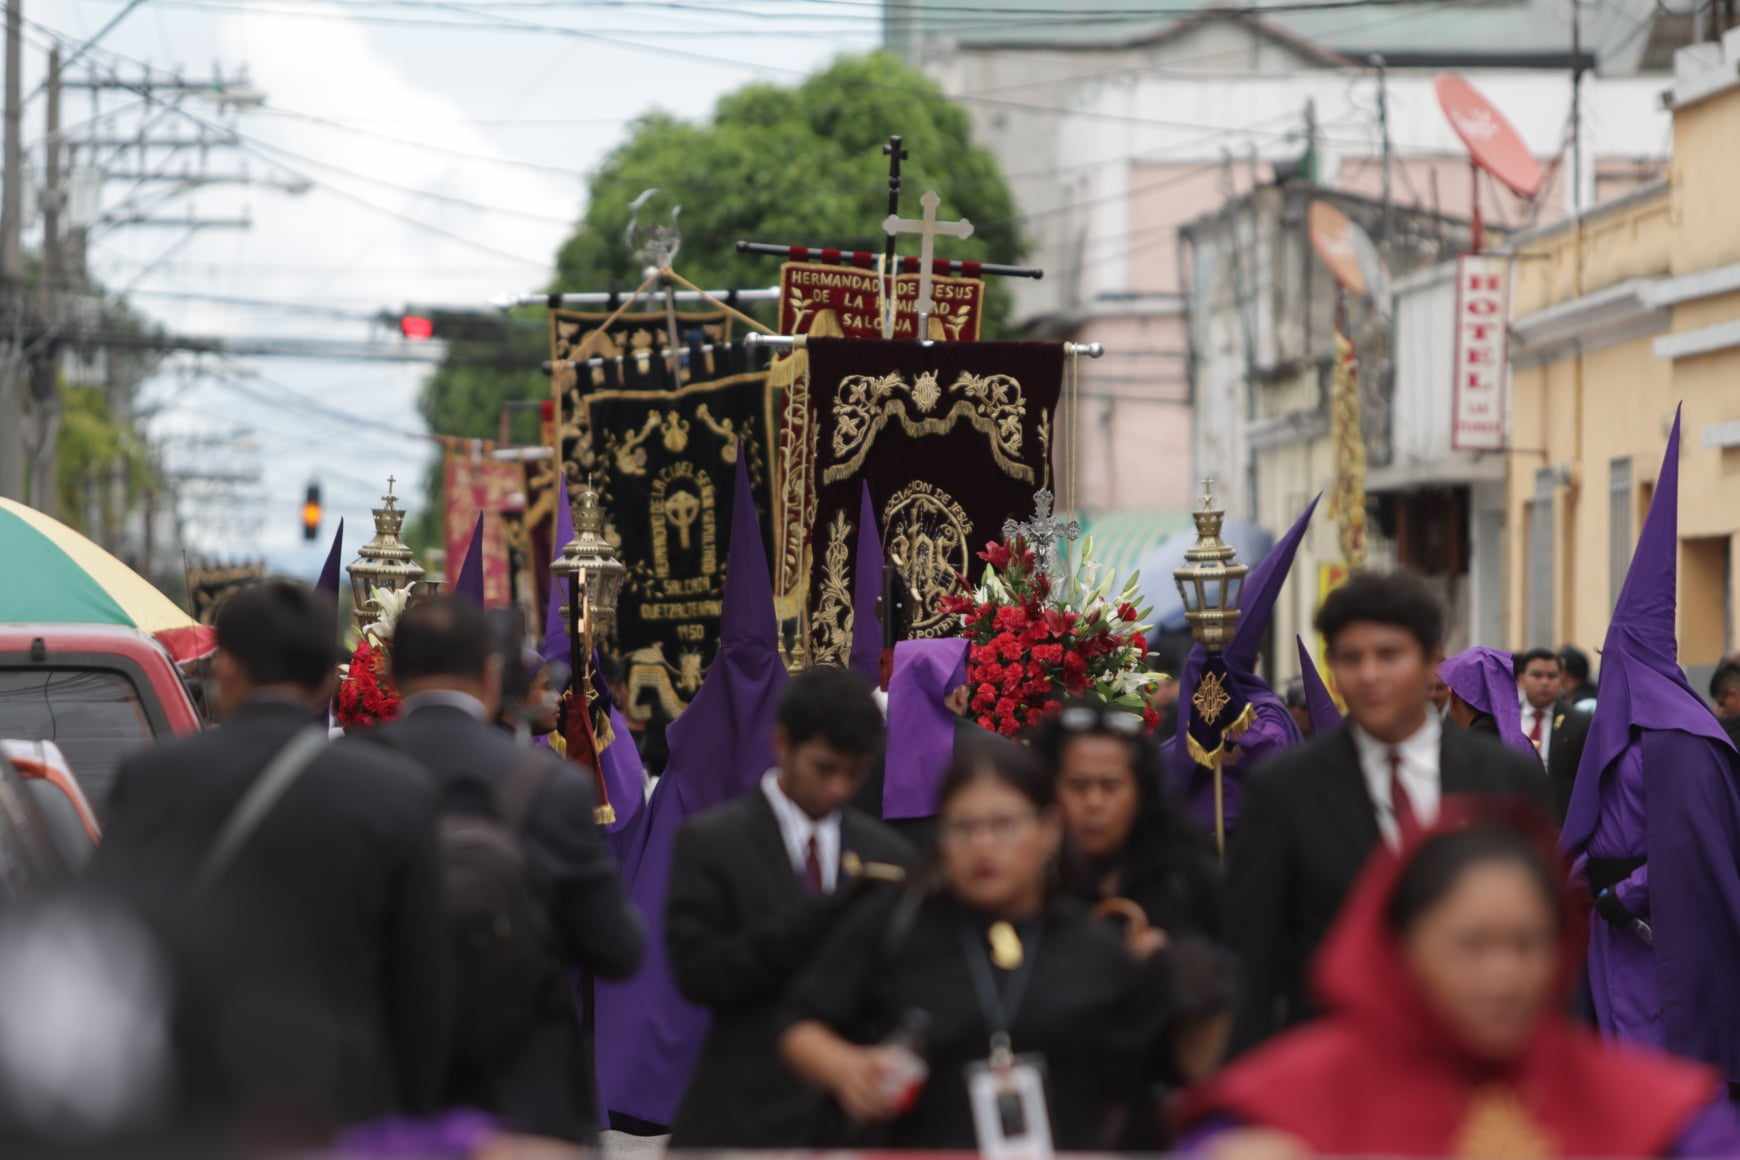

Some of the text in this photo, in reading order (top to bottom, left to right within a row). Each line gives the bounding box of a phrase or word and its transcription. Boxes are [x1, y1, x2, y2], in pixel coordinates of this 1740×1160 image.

[791, 270, 974, 300] HERMANDAD DE ESUS
[813, 289, 831, 304] DE
[844, 293, 864, 310] LA
[842, 313, 912, 332] SALCJA
[1466, 274, 1501, 392] HOTEL
[934, 488, 952, 504] DE
